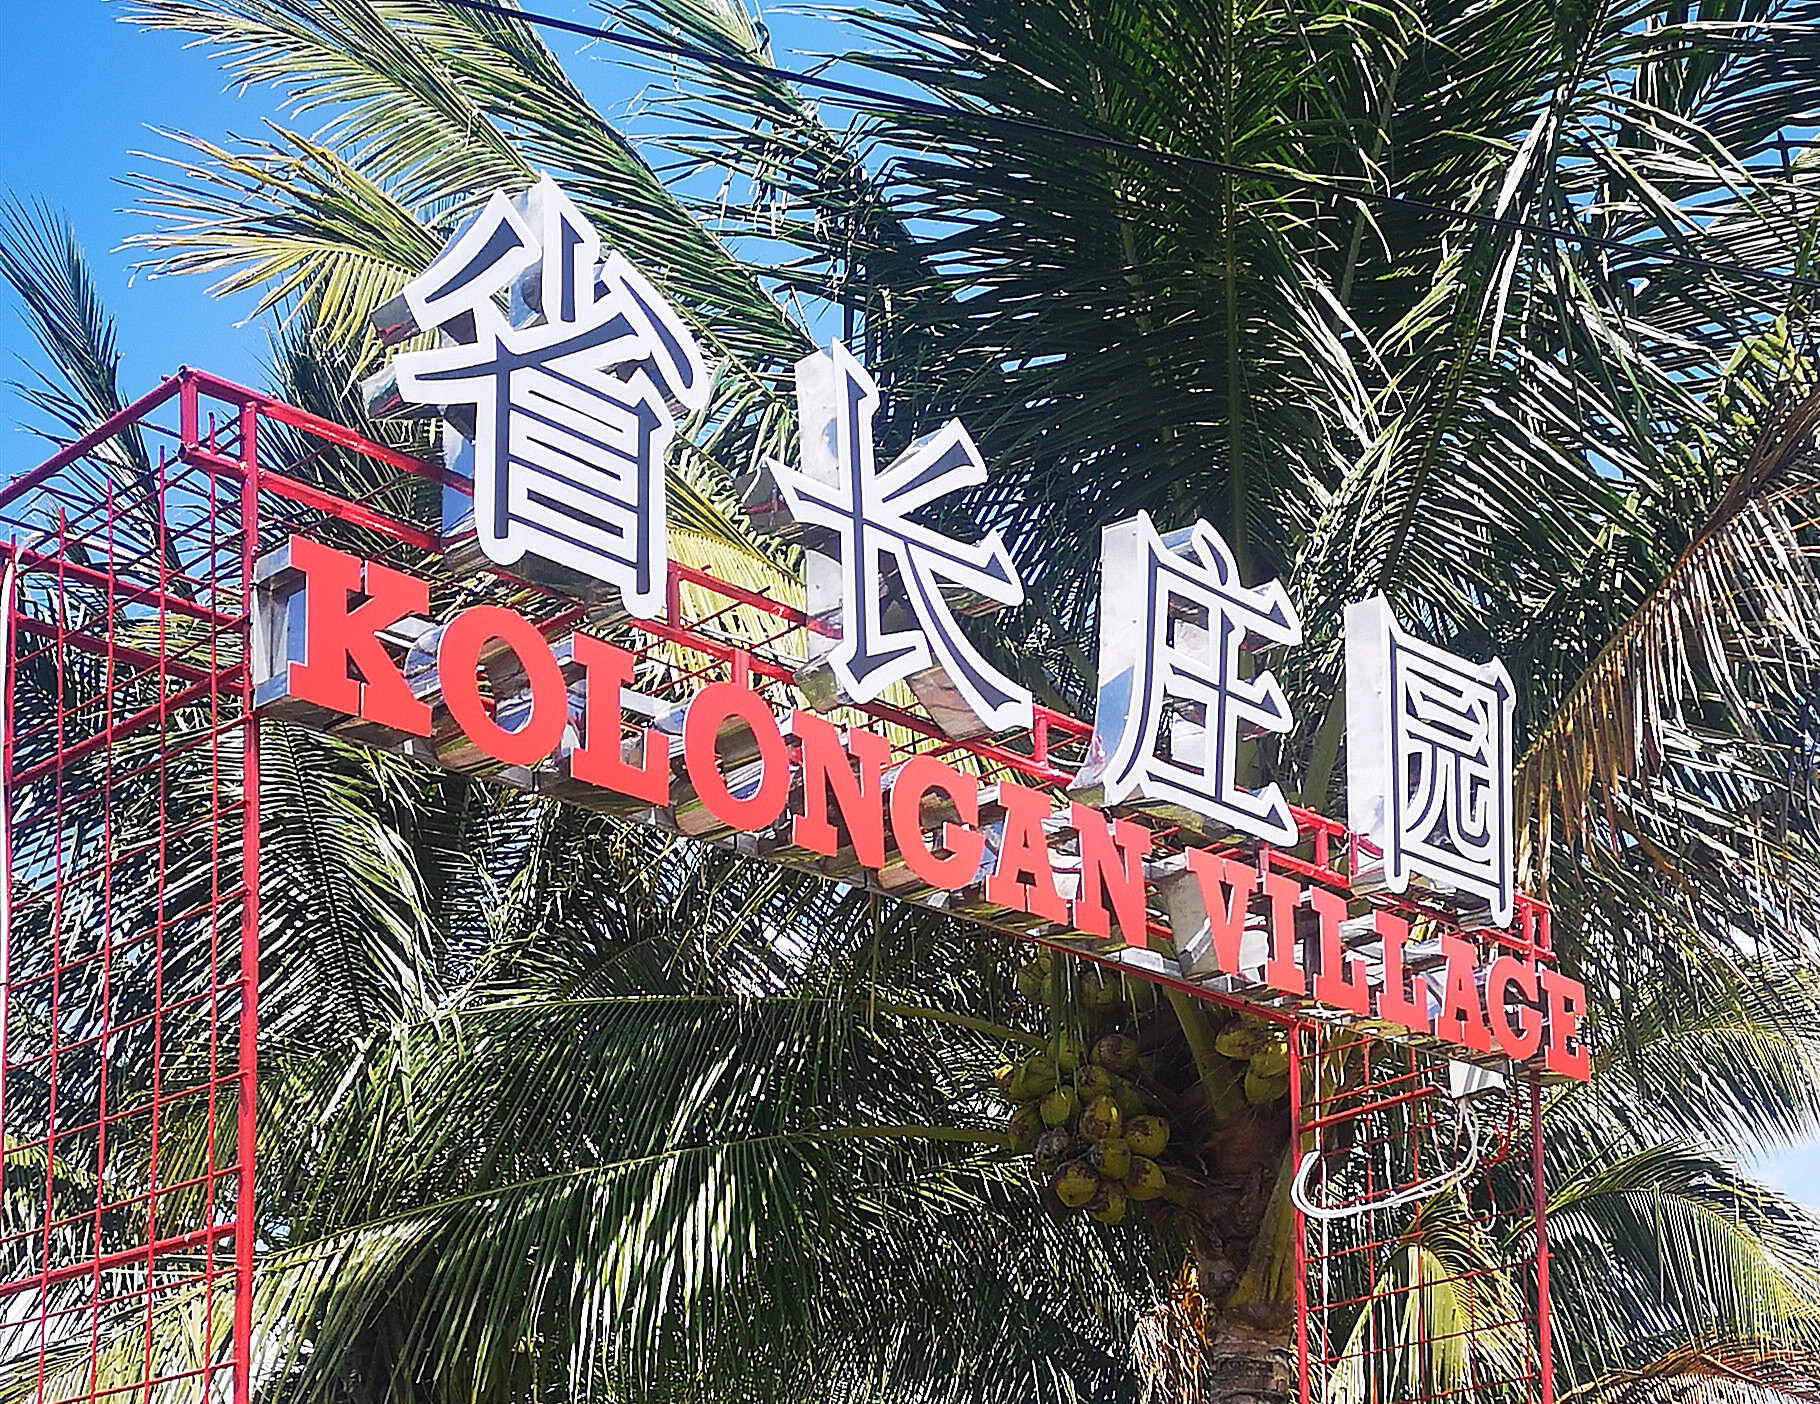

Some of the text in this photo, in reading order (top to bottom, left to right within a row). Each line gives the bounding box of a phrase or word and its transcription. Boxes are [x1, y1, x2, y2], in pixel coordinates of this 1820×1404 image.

[287, 533, 1591, 1083] KOLONGAN VILLAGE
[392, 171, 1517, 928] 省长庄园
